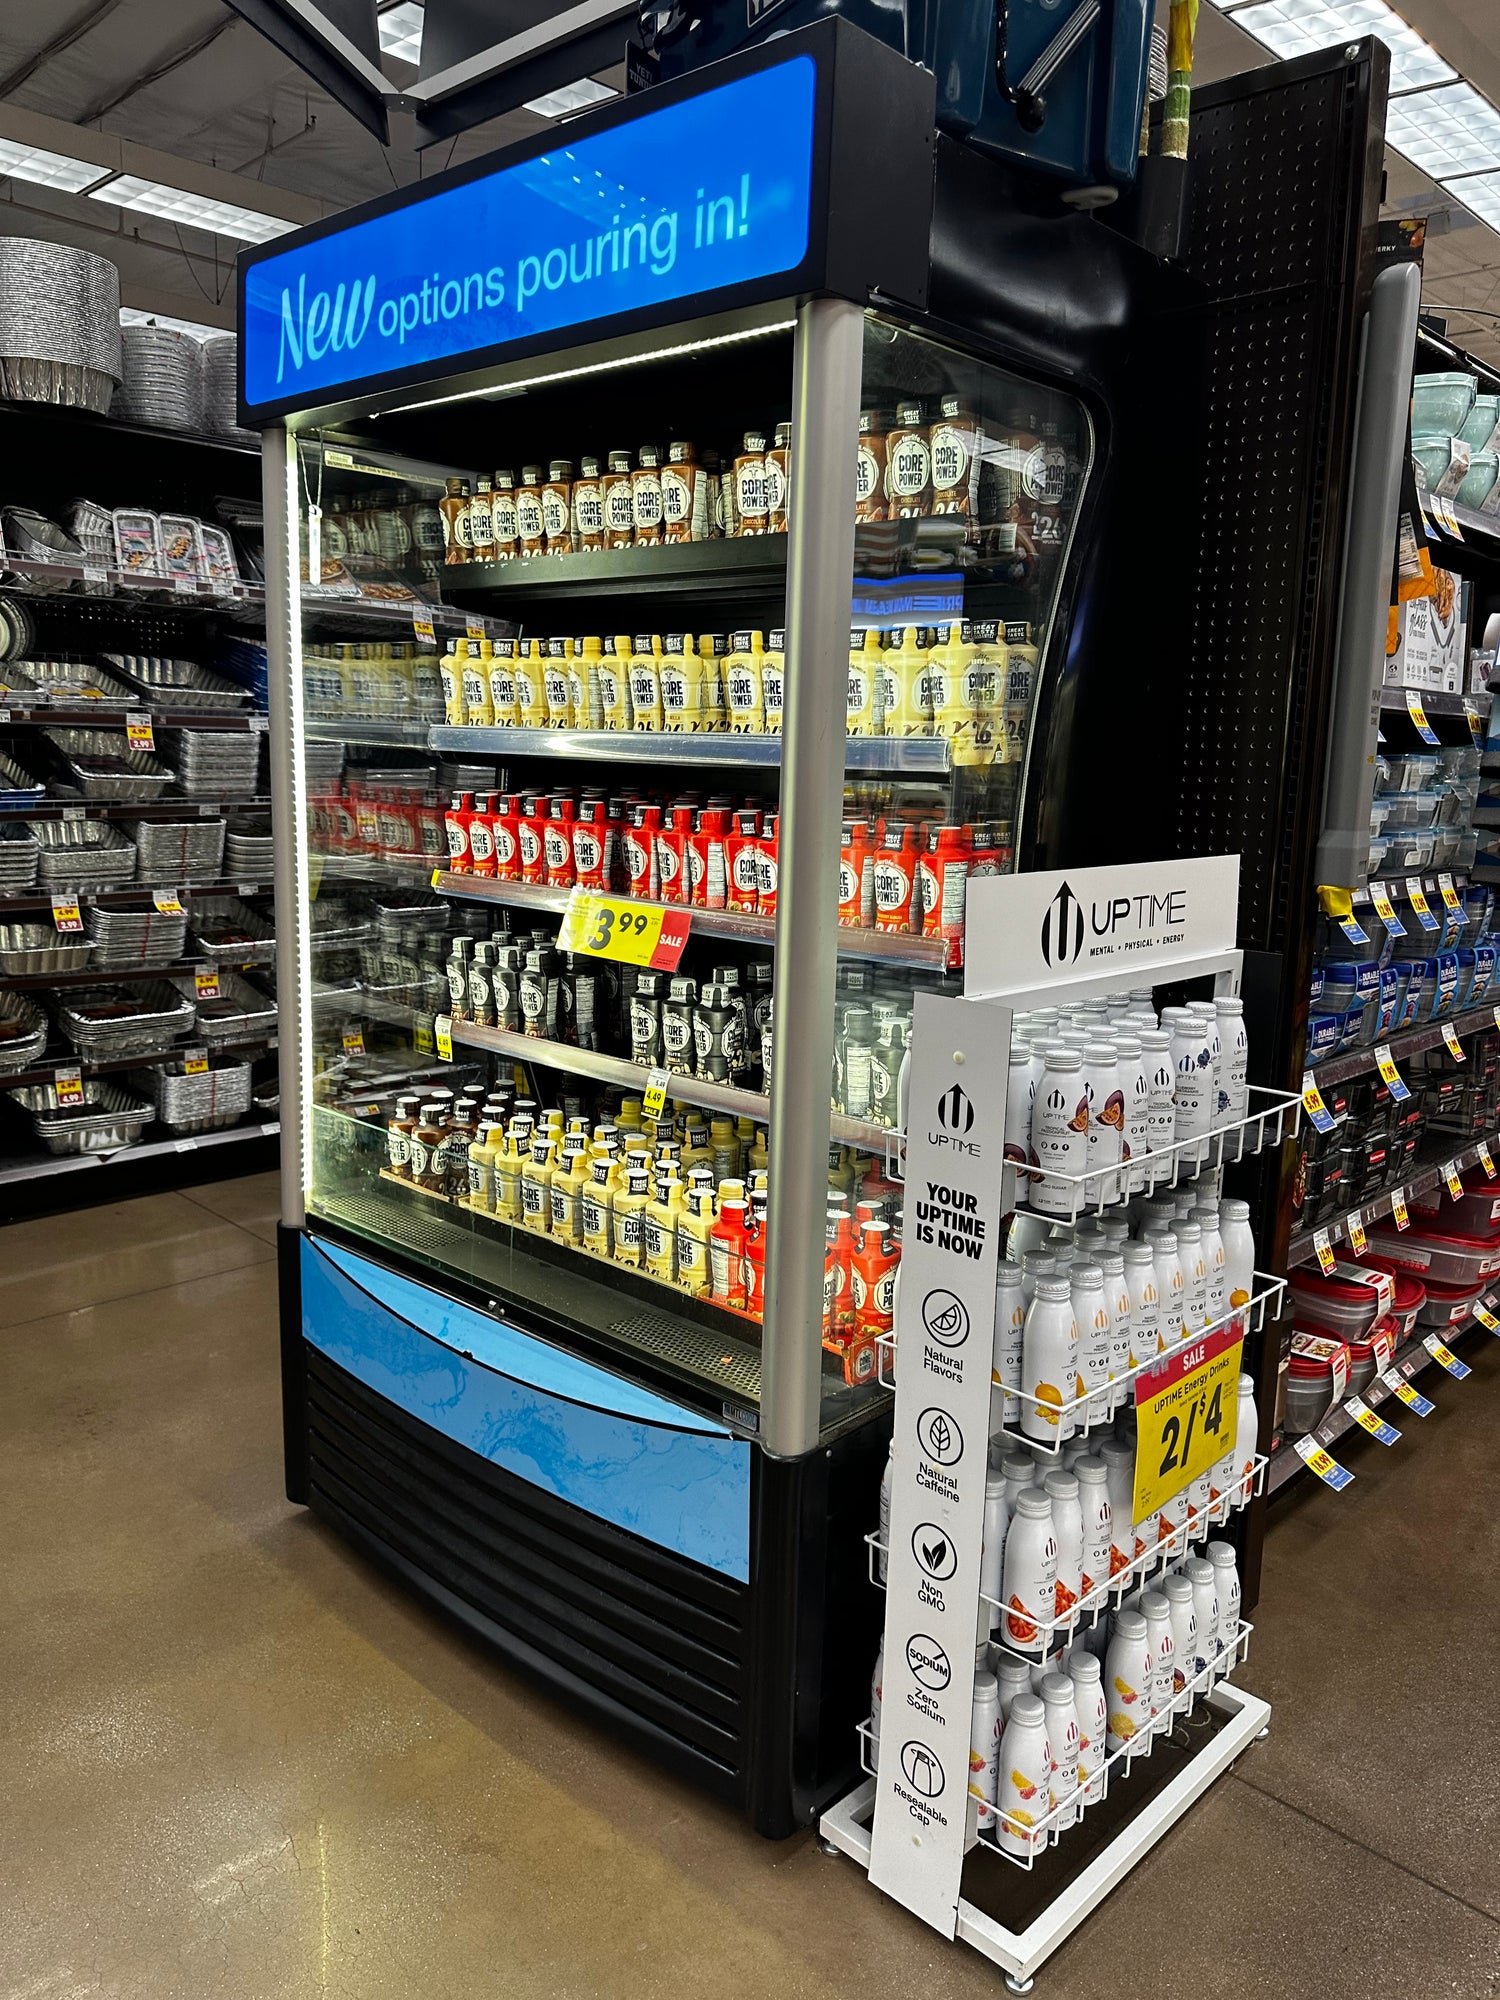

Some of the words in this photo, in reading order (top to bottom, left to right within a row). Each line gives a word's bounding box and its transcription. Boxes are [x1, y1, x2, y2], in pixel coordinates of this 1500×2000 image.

[277, 273, 376, 384] New
[378, 265, 504, 346] options
[517, 212, 679, 312] pouring
[694, 173, 750, 250] in!
[936, 446, 958, 464] CORE
[899, 454, 923, 472] CORE
[899, 472, 922, 486] POWER
[936, 465, 957, 479] POWER
[742, 479, 768, 494] CORE
[612, 498, 633, 511] CORE
[637, 492, 660, 506] CORE
[742, 496, 768, 507] POWER
[520, 508, 539, 520] CORE
[578, 502, 601, 515] CORE
[638, 508, 659, 518] POWER
[473, 516, 491, 528] CORE
[497, 512, 515, 524] CORE
[580, 516, 602, 526] POWER
[497, 526, 516, 535] POWER
[520, 521, 540, 531] POWER
[492, 681, 514, 692] CORE
[632, 679, 653, 692] CORE
[730, 680, 751, 694] CORE
[969, 672, 995, 689] CORE
[662, 681, 683, 695] CORE
[968, 689, 995, 701] POWER
[731, 695, 752, 705] POWER
[133, 740, 150, 748] 2.99
[877, 876, 899, 891] CORE
[877, 892, 899, 903] POWER
[1413, 897, 1427, 910] 12.99
[1445, 893, 1458, 905] 12.99
[1091, 890, 1187, 935] UPTIME
[1377, 905, 1393, 916] 12.99
[60, 921, 78, 929] 2.99
[660, 934, 682, 947] SALE
[1090, 945, 1114, 956] MENTAL
[1124, 938, 1153, 950] PHYSICAL
[1162, 933, 1185, 945] ENERGY
[1478, 959, 1494, 968] DURABLE
[1362, 969, 1380, 982] DURABLE
[1441, 967, 1457, 977] DURABLE
[1383, 983, 1397, 995] DURABLE
[665, 1024, 683, 1036] CORE
[1318, 1027, 1335, 1039] DURABLE
[666, 1037, 683, 1045] POWER
[1382, 1065, 1395, 1079] 7.99
[62, 1094, 80, 1103] 4.99
[647, 1091, 661, 1102] 4.49
[1306, 1093, 1319, 1109] 5.99
[1042, 1112, 1069, 1120] UPTIME
[928, 1132, 981, 1158] UPTIME
[926, 1182, 978, 1215] YOUR
[916, 1200, 986, 1240] UPTIME
[916, 1222, 934, 1244] IS
[938, 1230, 983, 1261] NOW
[1318, 1247, 1332, 1260] 12.99
[924, 1345, 963, 1371] Natural
[1183, 1345, 1205, 1371] SALE
[924, 1358, 963, 1384] Flavors
[1154, 1387, 1183, 1414] UPTIME
[1184, 1372, 1208, 1394] Energy
[1210, 1357, 1229, 1380] Drinks
[1361, 1412, 1381, 1430] 12.99
[919, 1462, 958, 1490] Natural
[916, 1474, 960, 1503] Caffeine
[921, 1579, 943, 1599] Non
[918, 1589, 946, 1612] GMO
[909, 1648, 948, 1678] SODIUM
[914, 1687, 939, 1709] Zero
[907, 1694, 946, 1726] Sodium
[894, 1782, 948, 1826] Resealable
[909, 1805, 930, 1827] Cap
